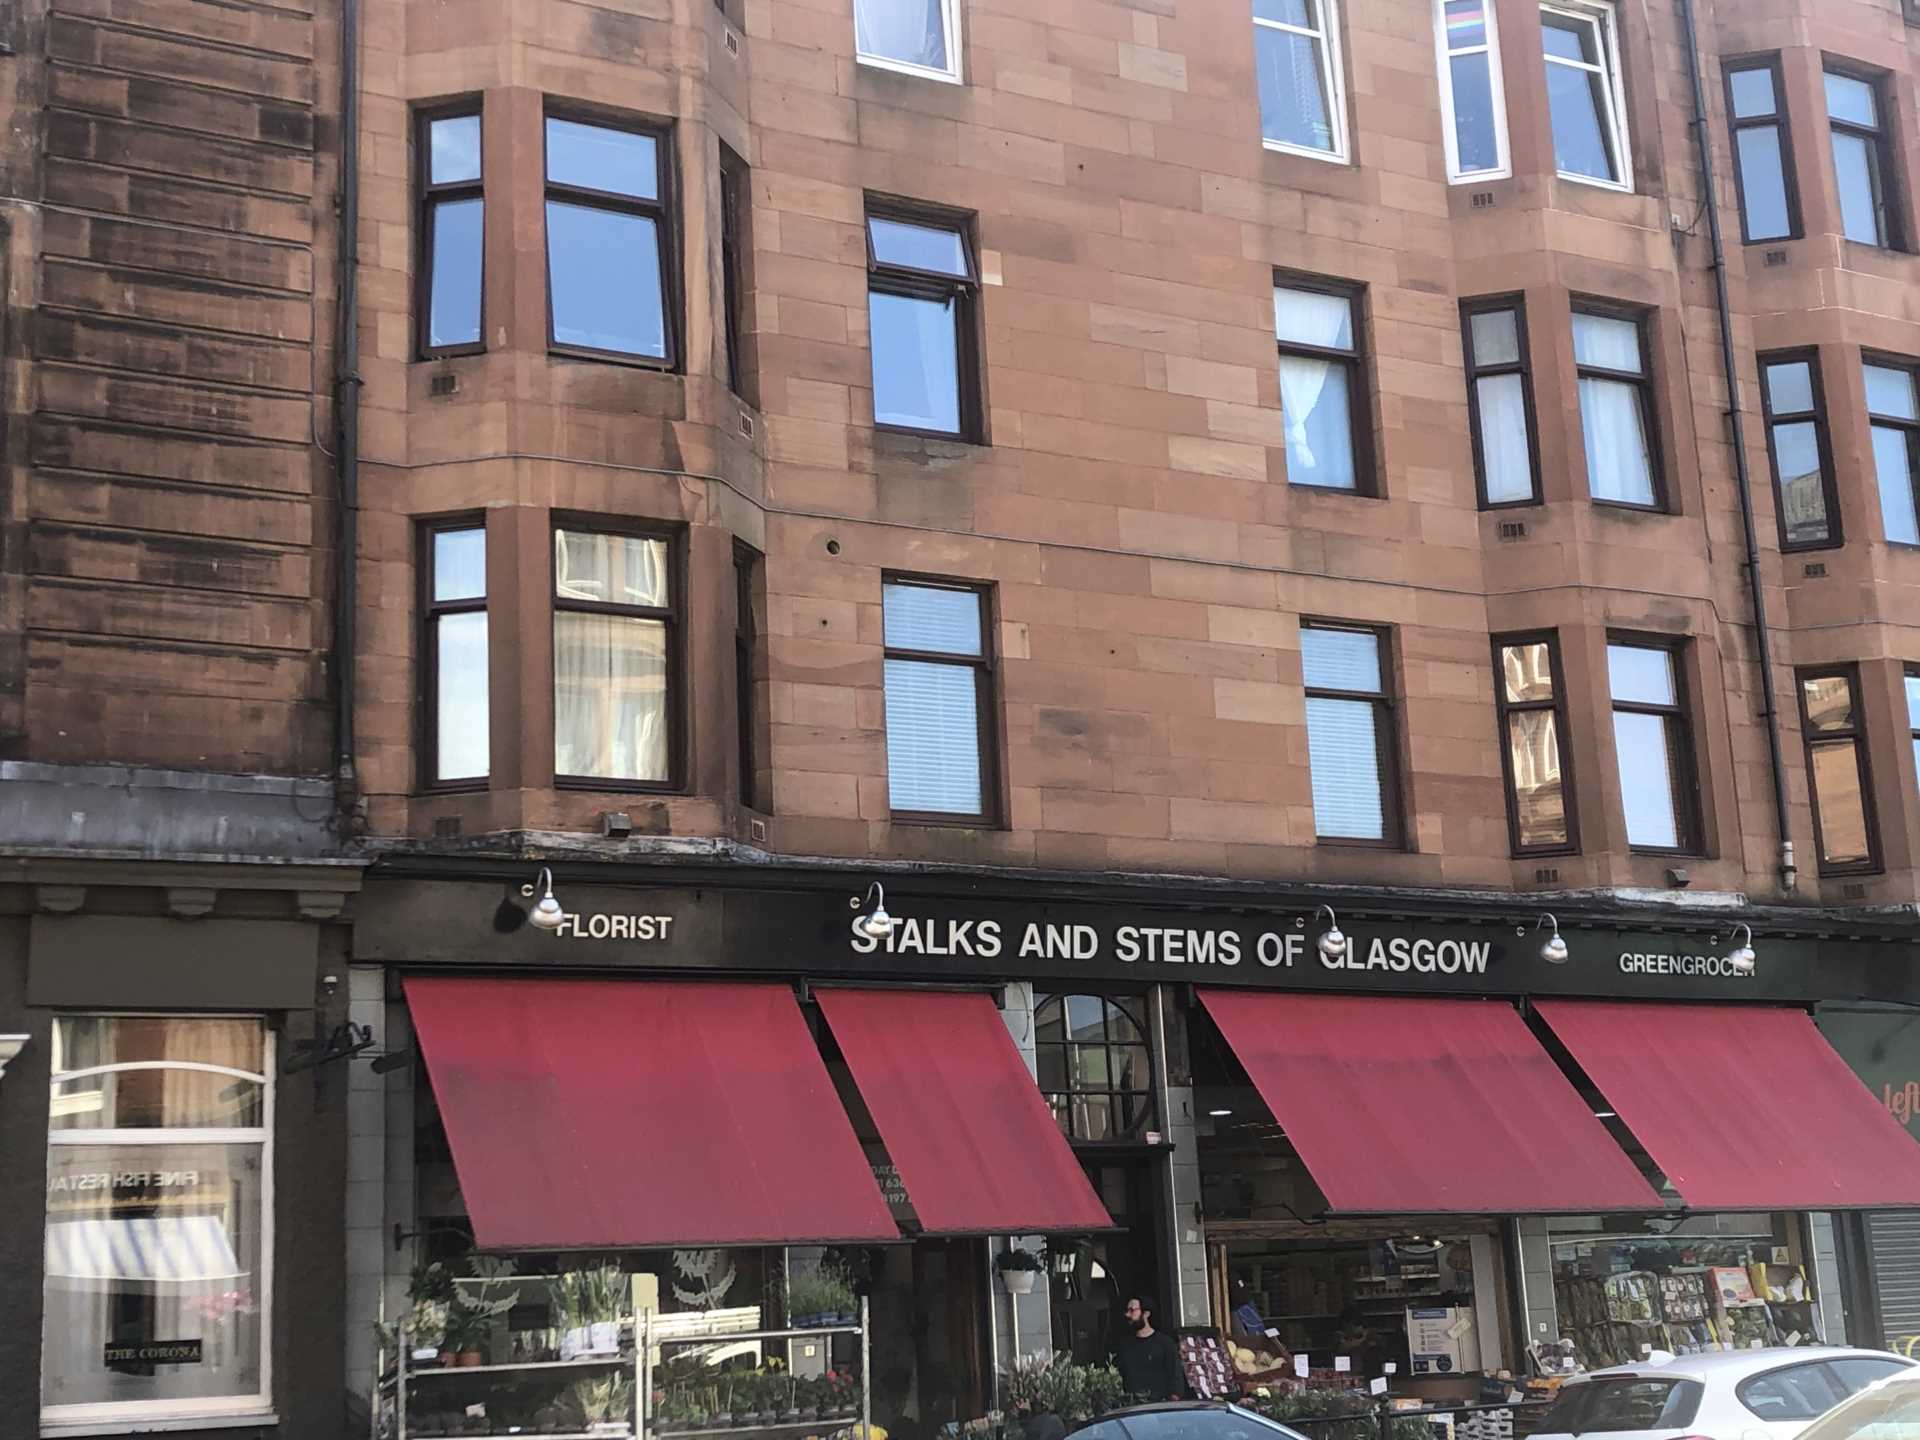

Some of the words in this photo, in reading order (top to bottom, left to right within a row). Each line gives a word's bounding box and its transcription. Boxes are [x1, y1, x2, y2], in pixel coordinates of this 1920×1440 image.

[556, 913, 673, 940] FLORIST
[850, 915, 1002, 958] STALKS
[1019, 923, 1098, 960] AND
[1115, 926, 1242, 966] STEMS
[1256, 931, 1305, 967] OF
[1619, 953, 1755, 977] GREENGROC
[139, 1346, 200, 1359] CORONA
